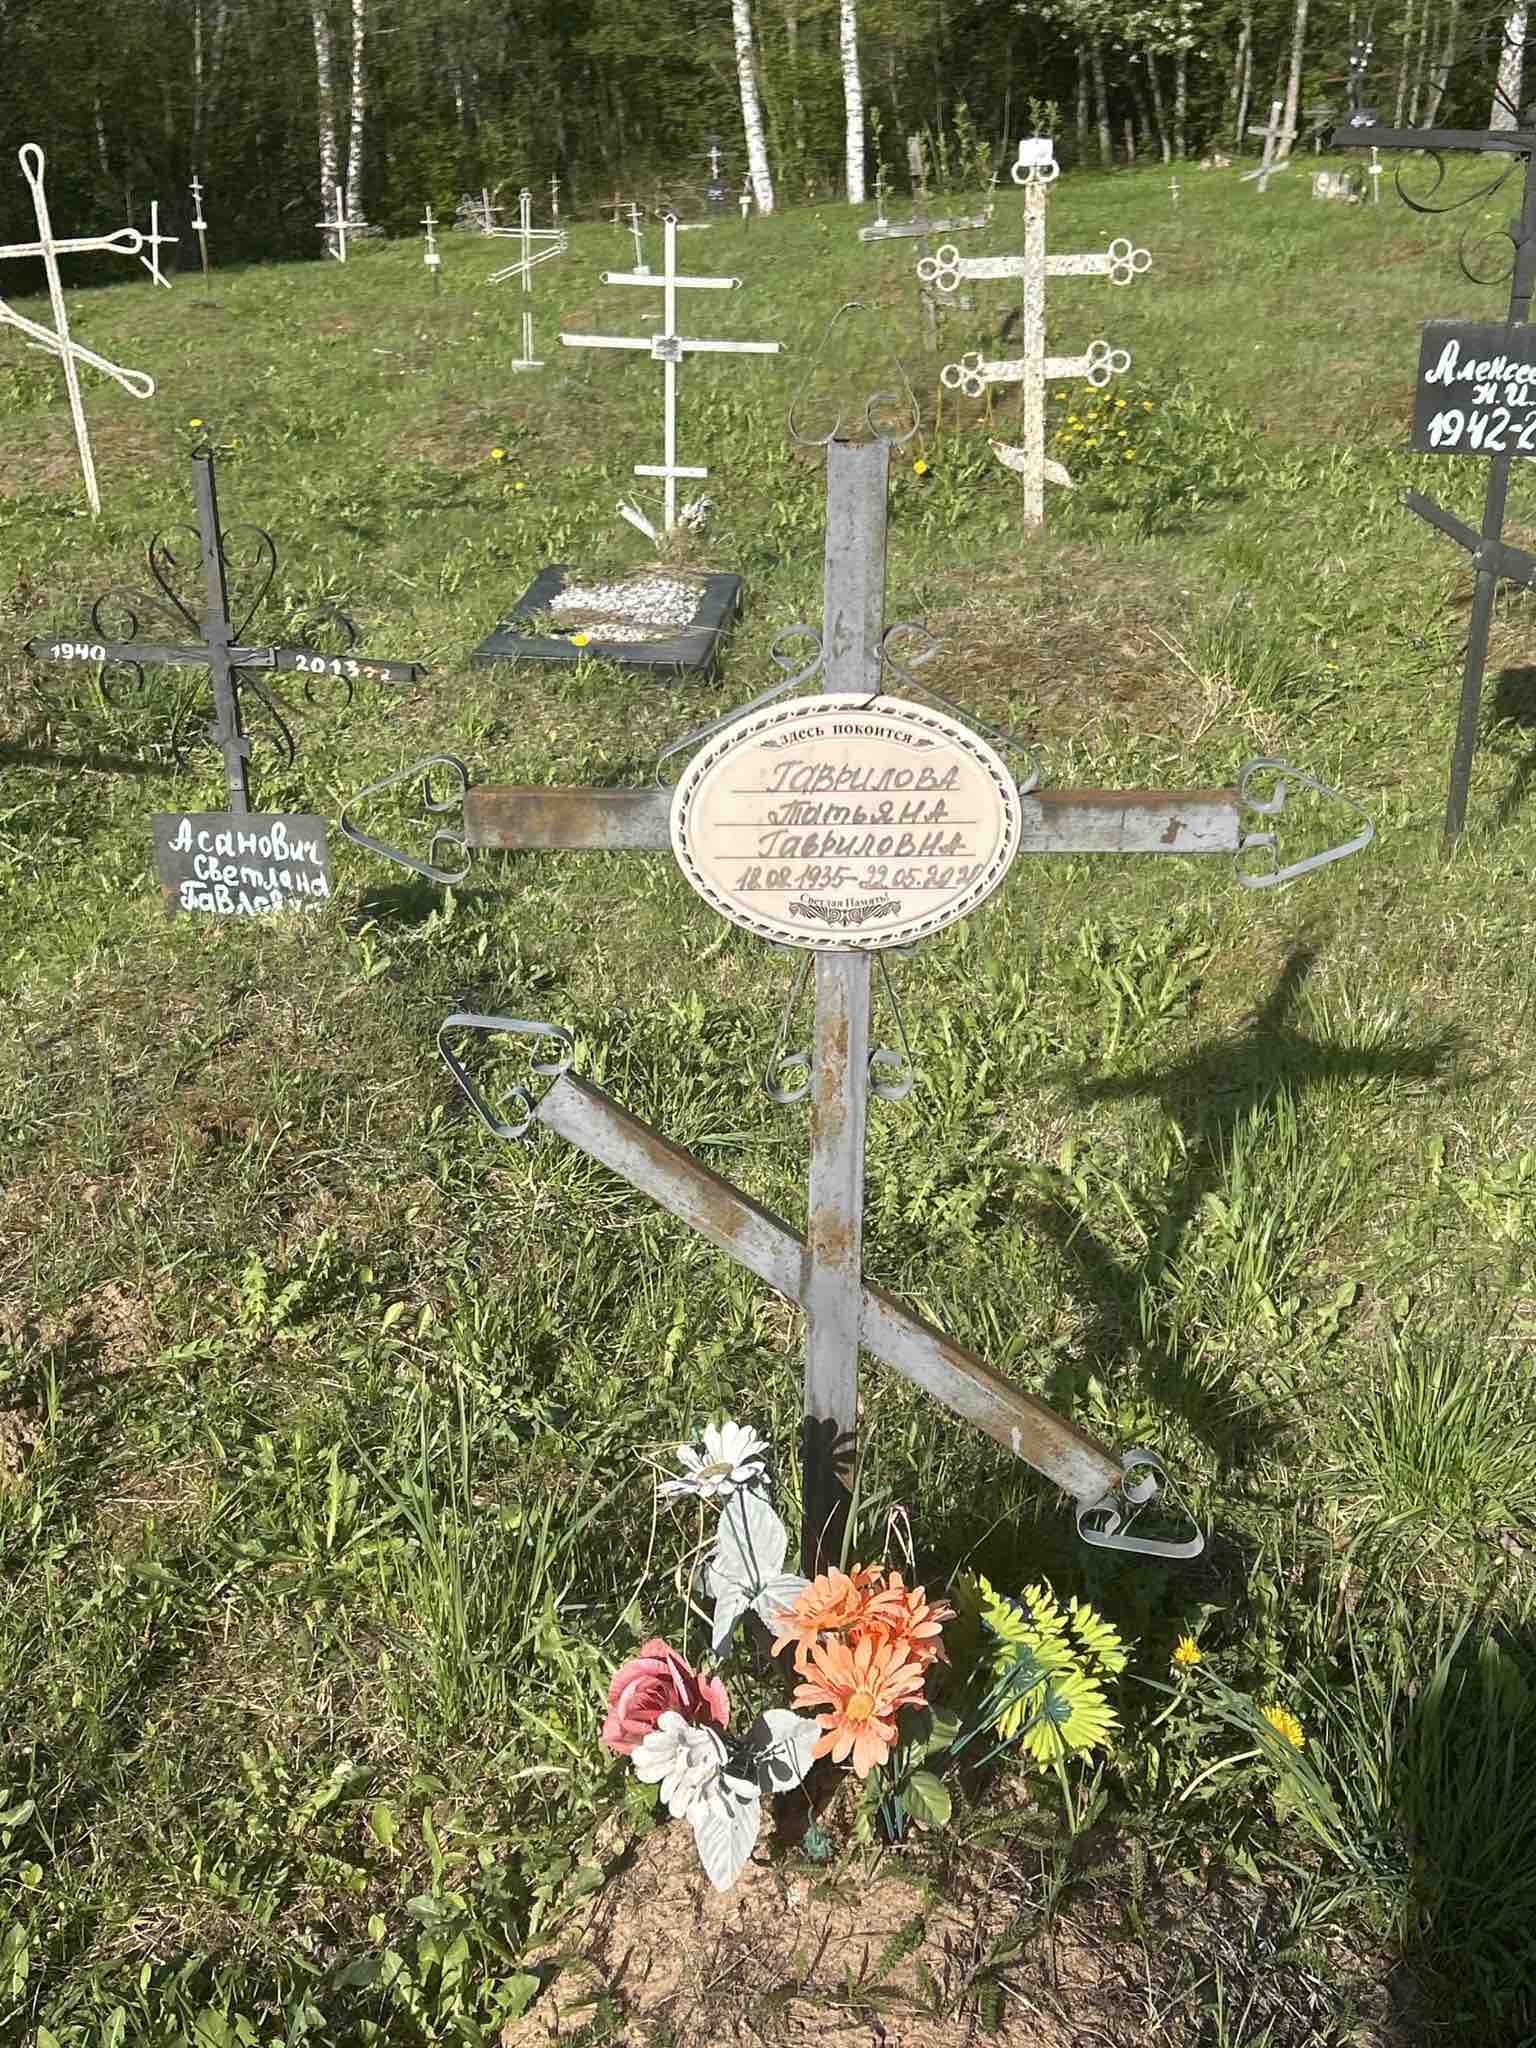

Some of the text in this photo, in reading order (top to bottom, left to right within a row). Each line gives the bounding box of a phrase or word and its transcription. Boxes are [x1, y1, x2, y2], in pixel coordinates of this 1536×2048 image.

[50, 643, 106, 660] 1940
[168, 817, 323, 865] Асанович
[194, 854, 331, 897] Светлана
